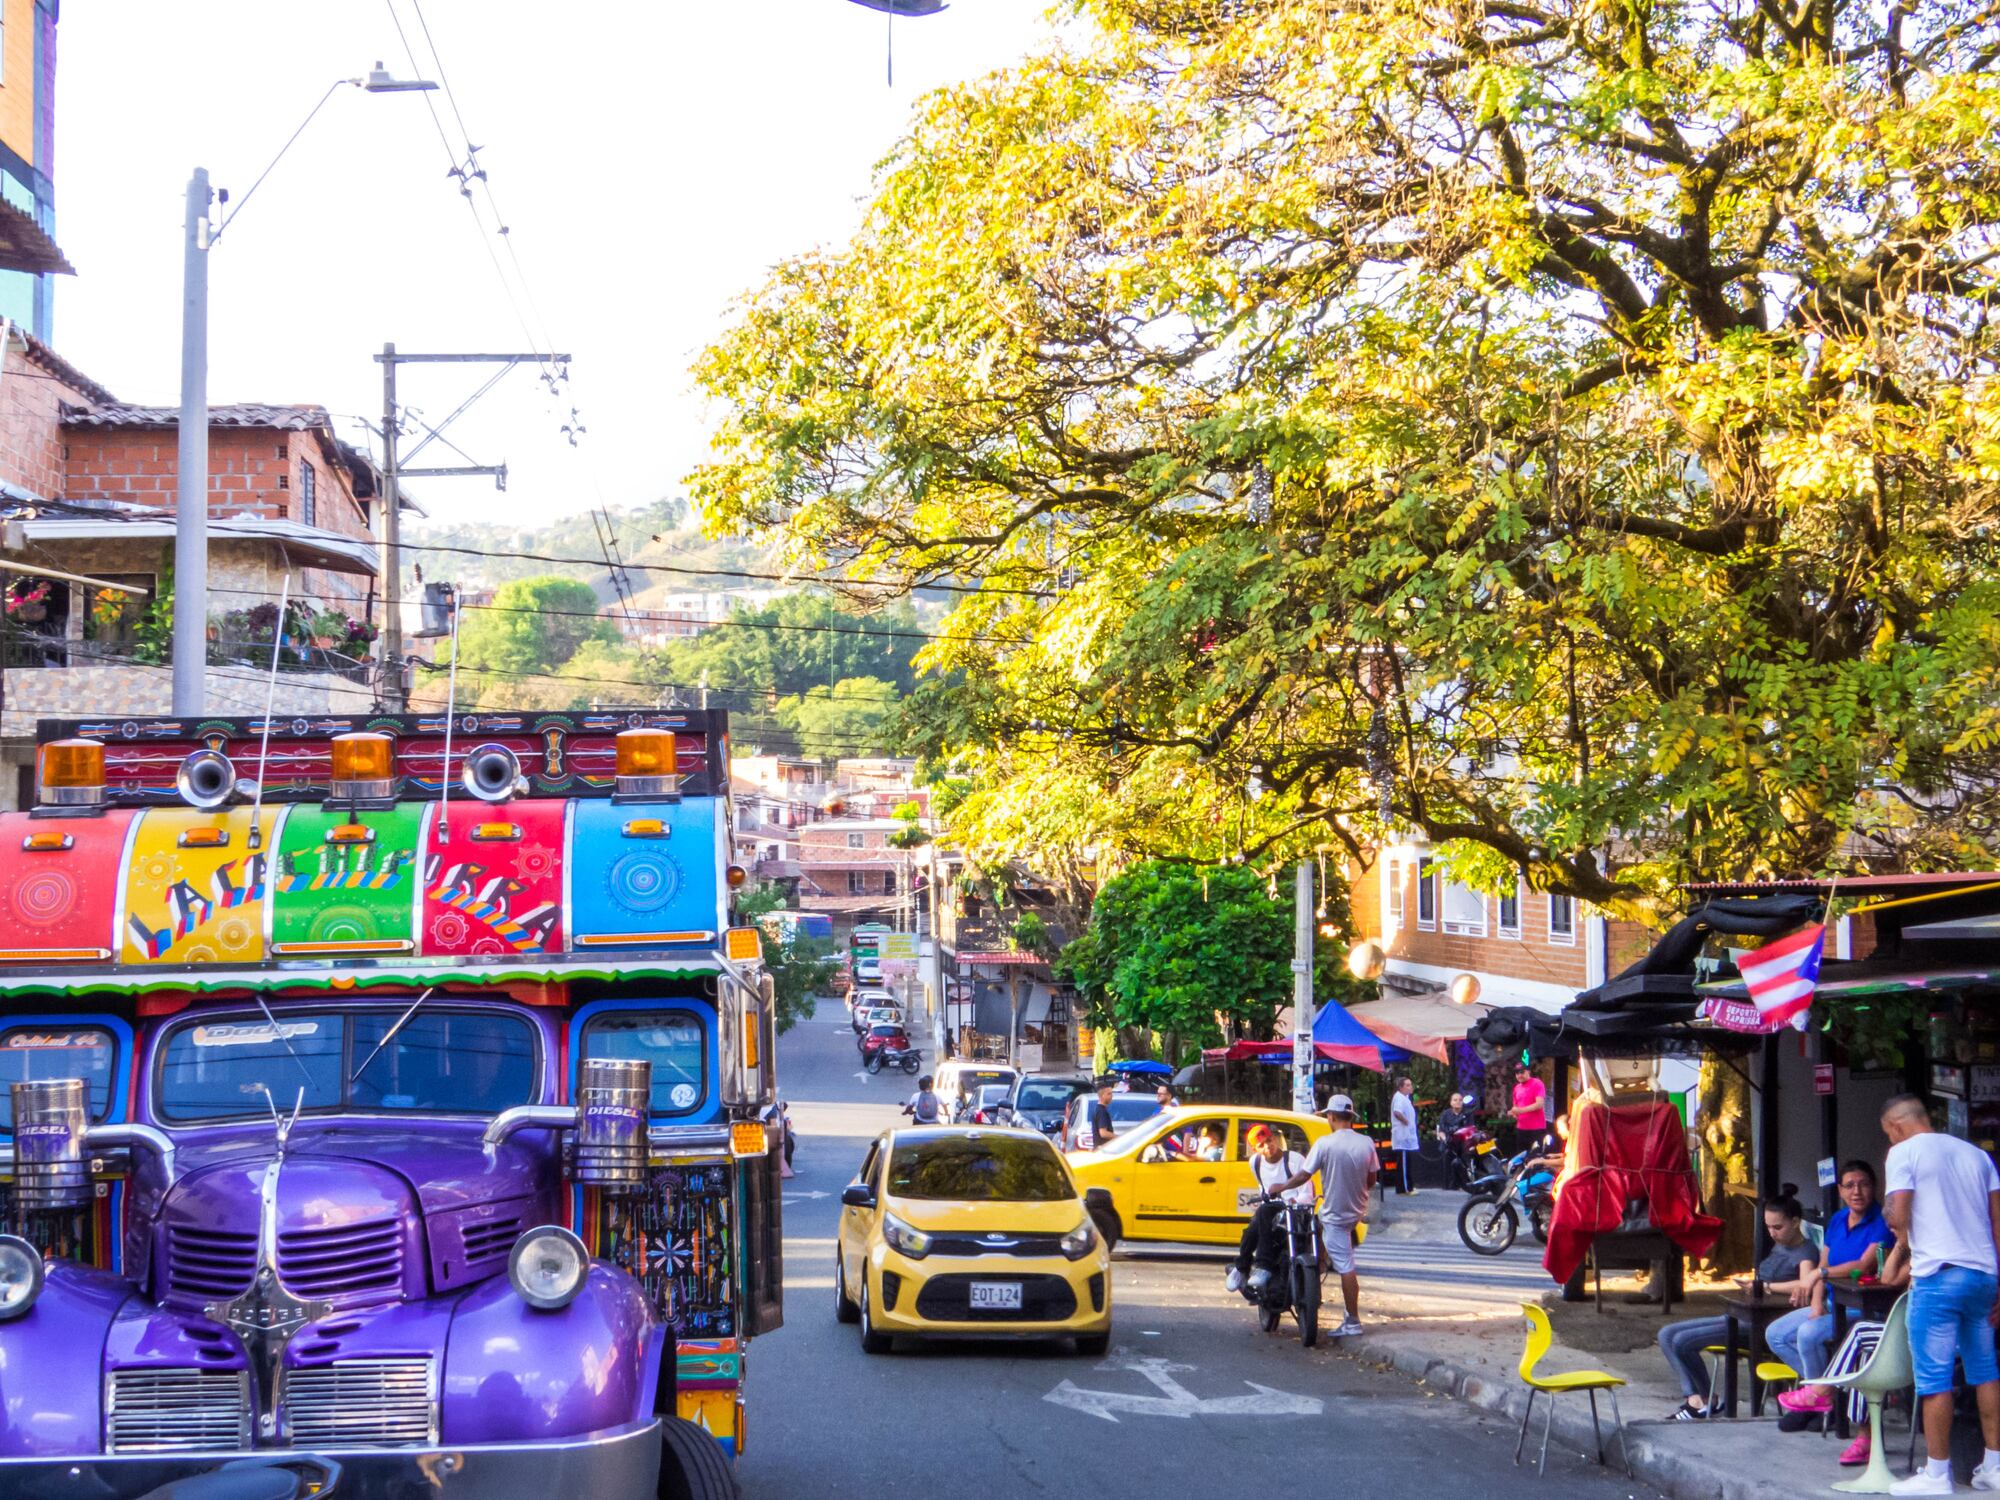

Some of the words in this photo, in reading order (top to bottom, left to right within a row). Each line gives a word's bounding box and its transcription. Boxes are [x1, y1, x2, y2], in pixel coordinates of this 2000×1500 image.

[1726, 1004, 1760, 1018] DEPORTIV
[587, 1106, 639, 1119] DIESEL
[18, 1125, 70, 1137] DIESEL
[231, 1307, 303, 1321] DODGE
